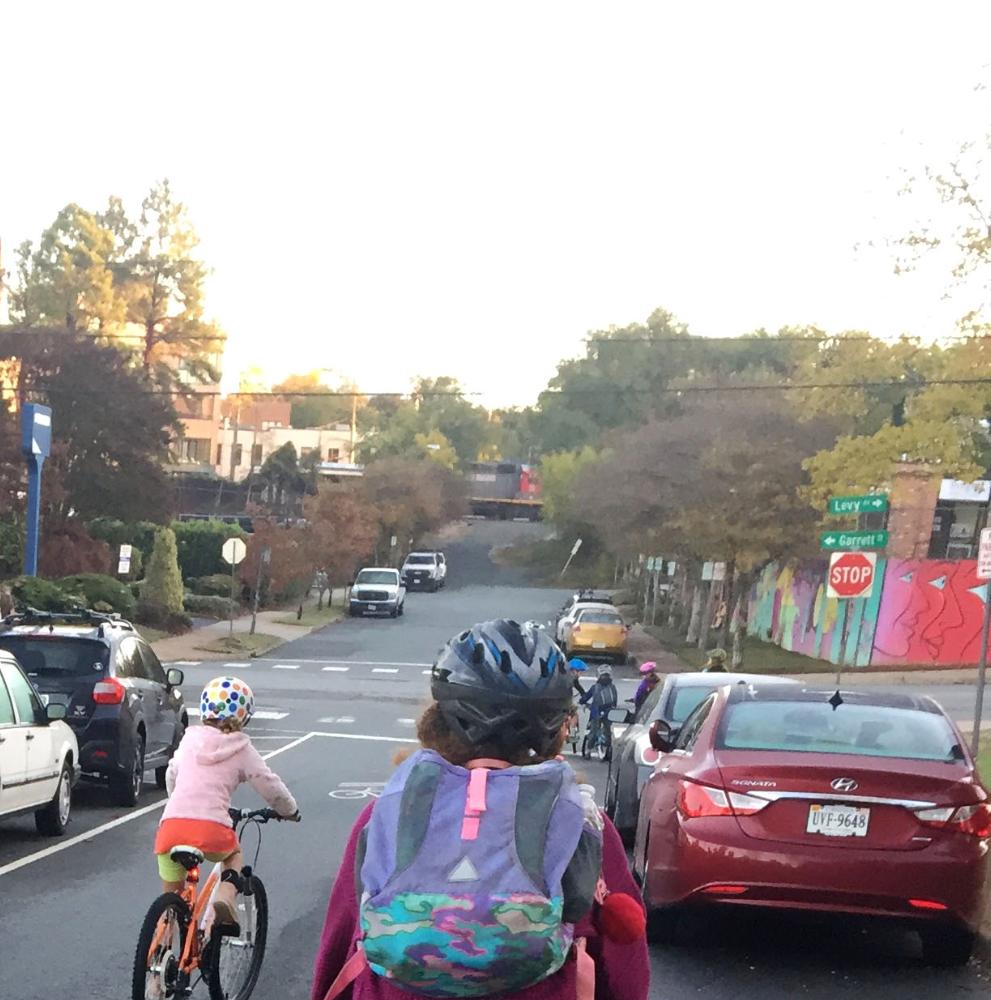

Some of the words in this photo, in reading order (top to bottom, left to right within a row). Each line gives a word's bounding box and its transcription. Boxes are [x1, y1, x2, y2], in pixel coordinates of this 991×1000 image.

[835, 500, 860, 512] Levy
[839, 535, 875, 546] Garrett
[831, 566, 872, 584] STOP
